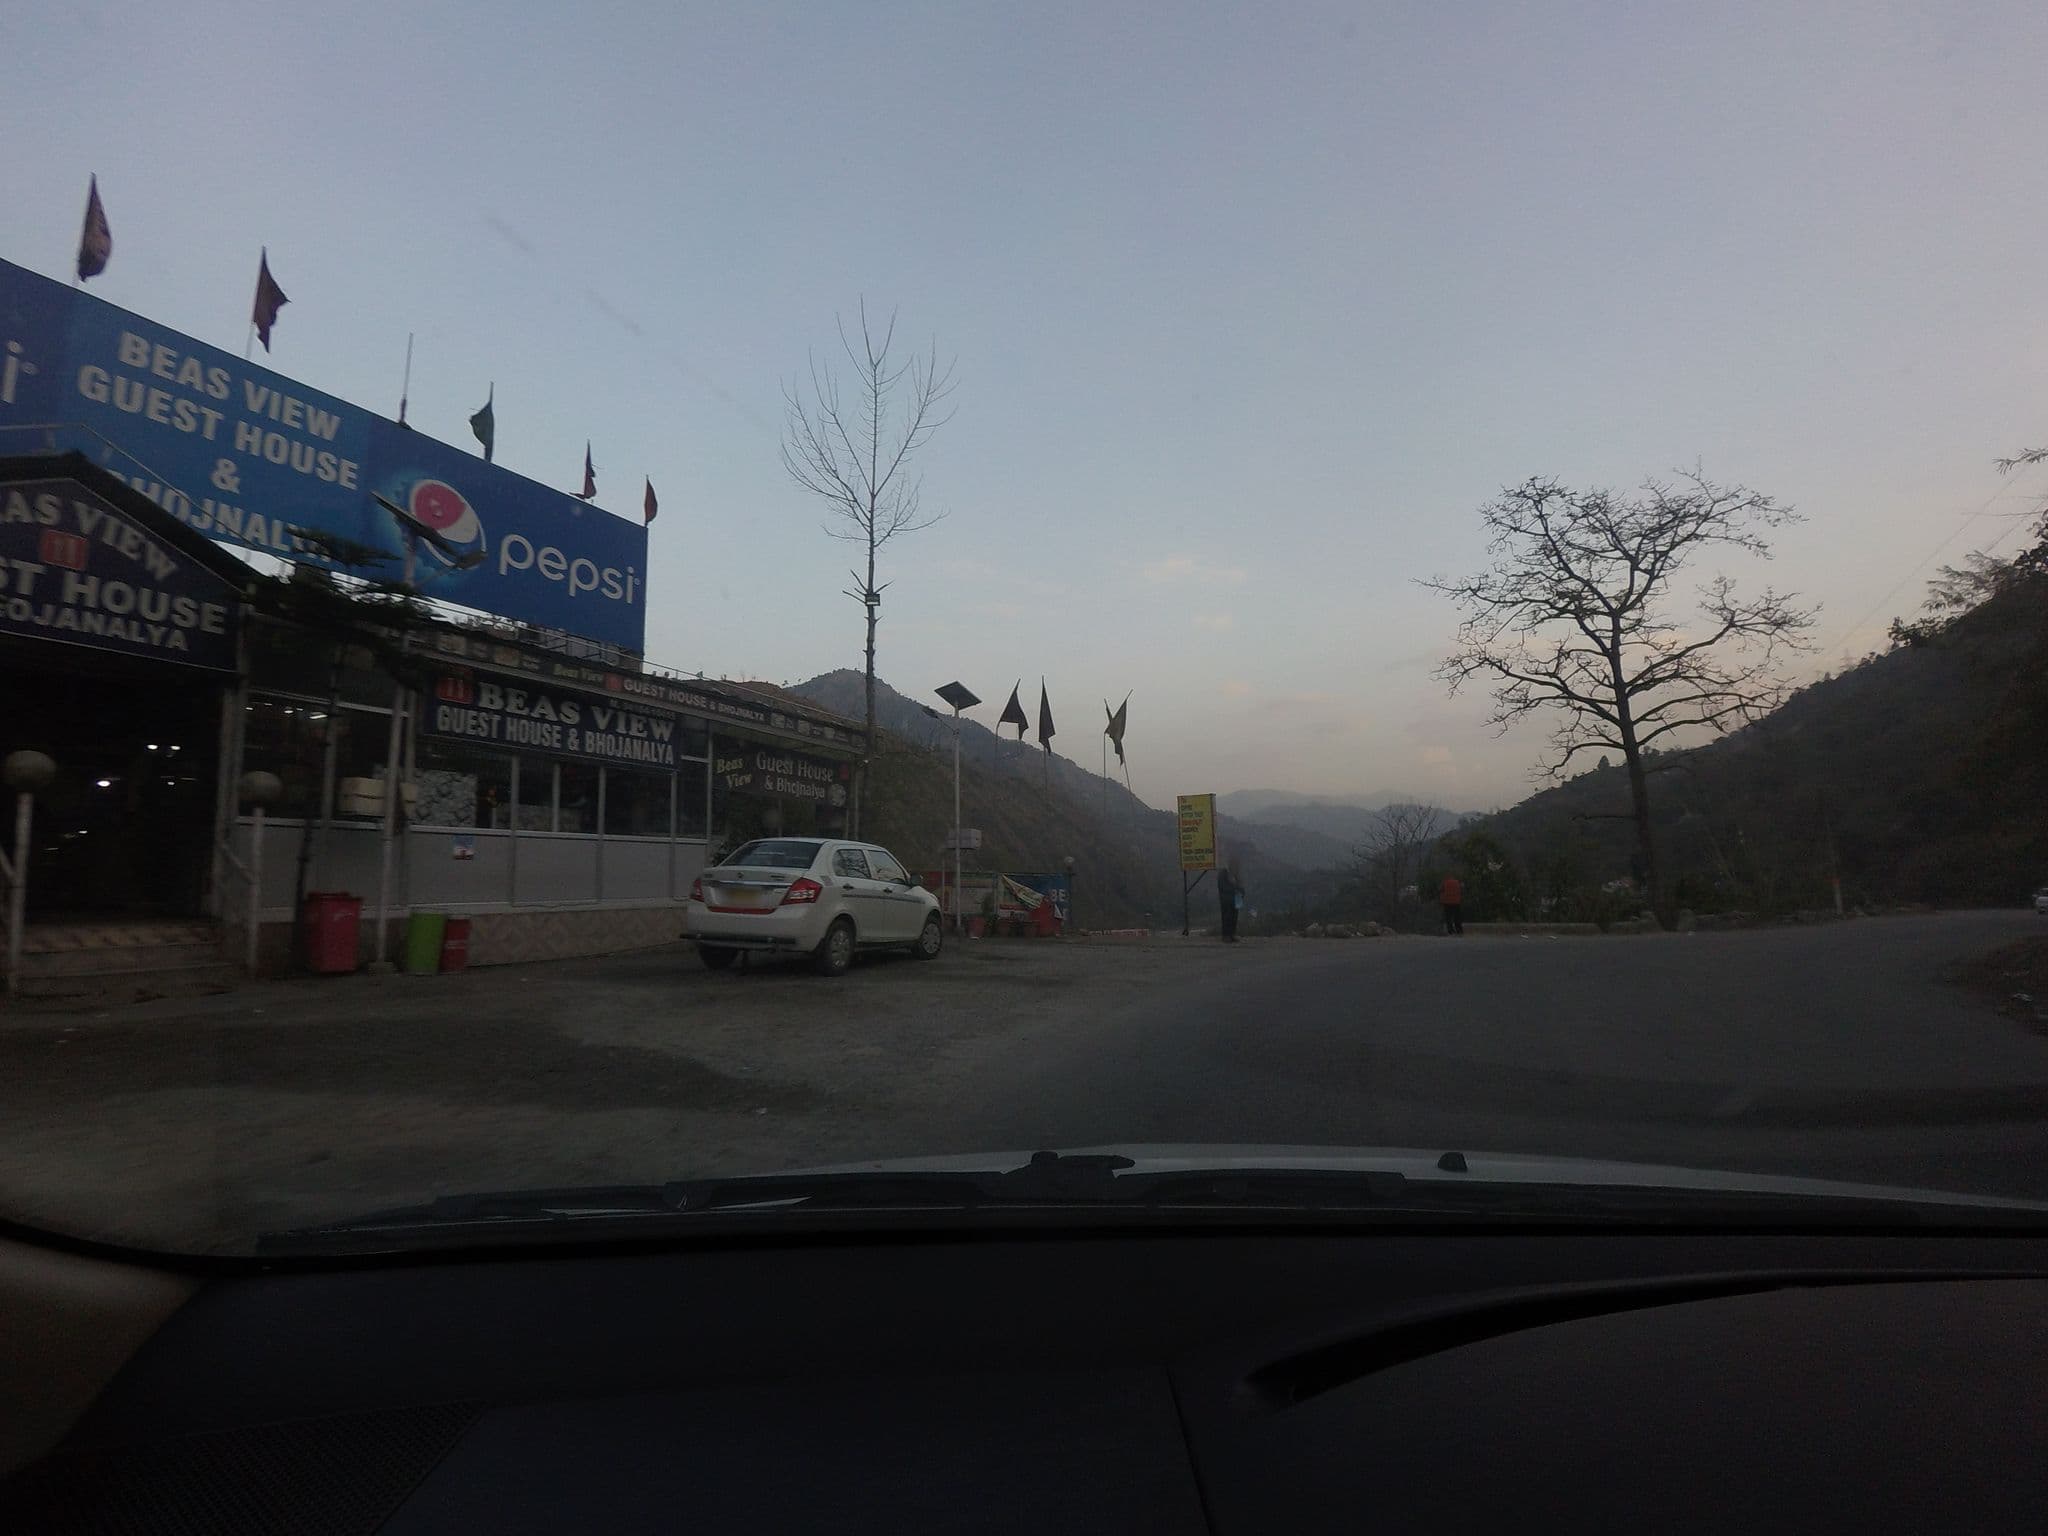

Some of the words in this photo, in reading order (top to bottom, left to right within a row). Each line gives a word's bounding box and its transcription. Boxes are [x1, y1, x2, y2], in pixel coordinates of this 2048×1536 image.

[118, 331, 231, 401] BEAS
[244, 379, 341, 441] VIEW
[78, 364, 224, 441] GUEST
[234, 421, 360, 491] HOUSE
[210, 457, 241, 495] &
[71, 498, 179, 582] VIEW
[500, 533, 634, 605] pepsi
[0, 595, 190, 651] OJANALYA
[61, 570, 225, 635] HOUSE
[479, 681, 581, 725] BEAS
[591, 705, 676, 742] VIEW
[624, 679, 665, 698] GUEST
[669, 686, 706, 709] HOUSE
[437, 704, 502, 739] GUEST
[506, 717, 562, 750] HOUSE
[567, 728, 581, 752] &
[585, 731, 674, 766] BHOJANALYA
[756, 751, 793, 776] Guest
[798, 761, 833, 783] House
